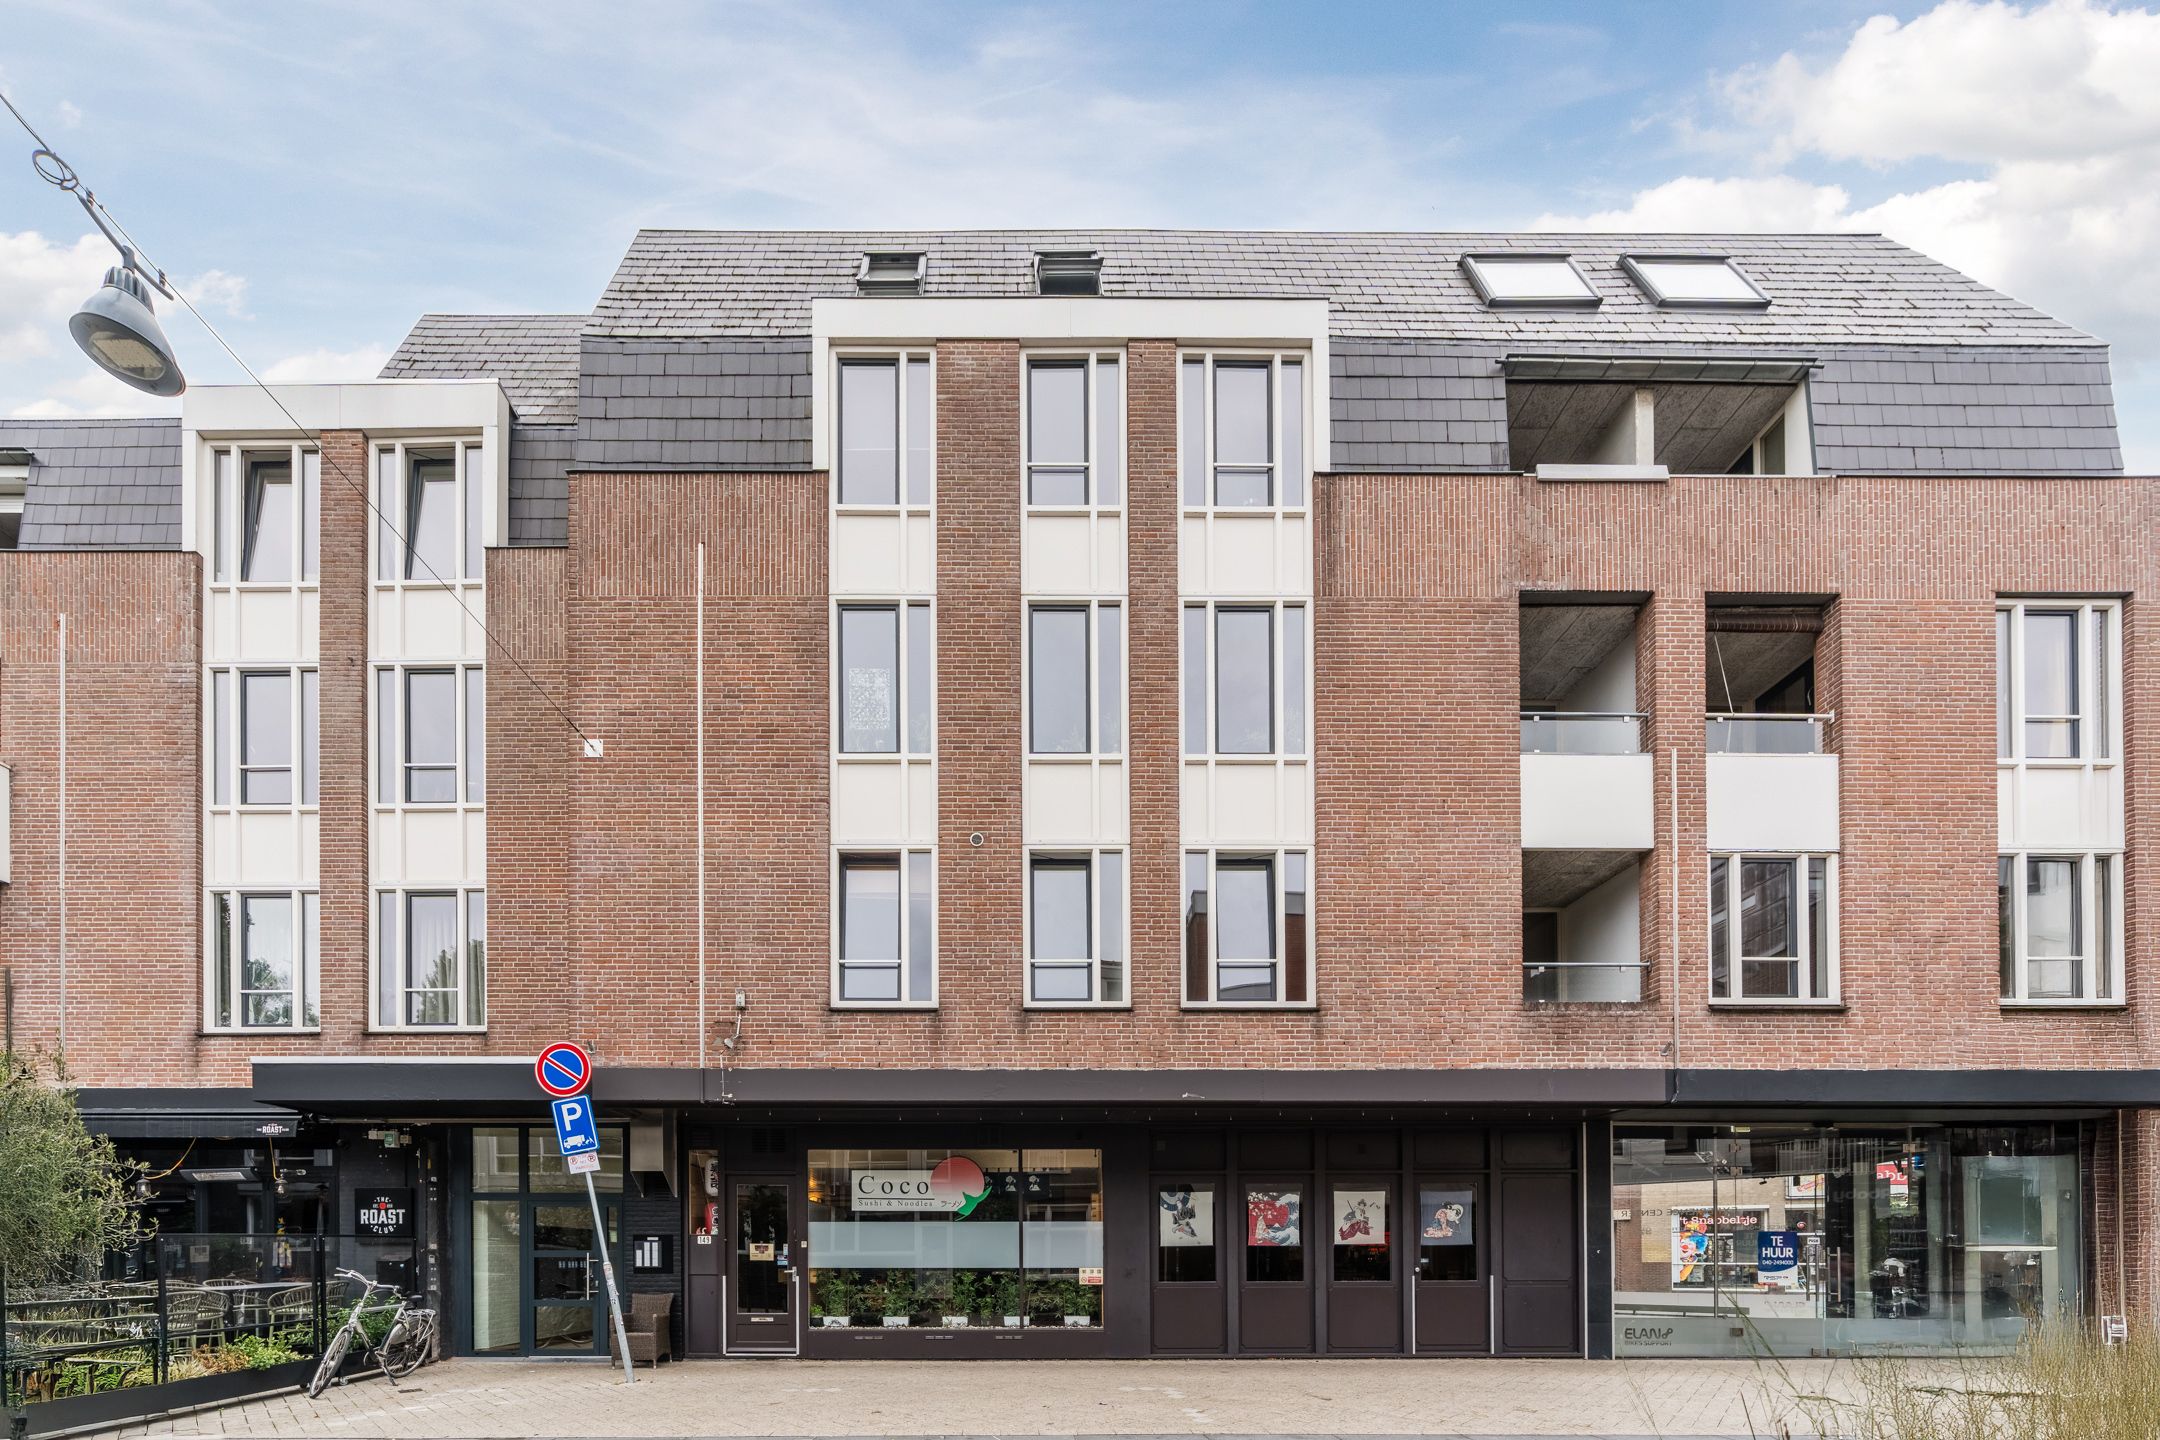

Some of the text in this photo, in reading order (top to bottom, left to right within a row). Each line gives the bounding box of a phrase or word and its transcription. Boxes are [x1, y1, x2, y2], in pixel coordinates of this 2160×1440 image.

[561, 1102, 582, 1131] P
[858, 1175, 929, 1194] Coco
[360, 1209, 406, 1225] ROAST
[372, 1225, 394, 1234] CLUB
[1770, 1236, 1784, 1246] TE
[1762, 1247, 1794, 1258] HUUR
[1625, 1328, 1661, 1339] ELAN
